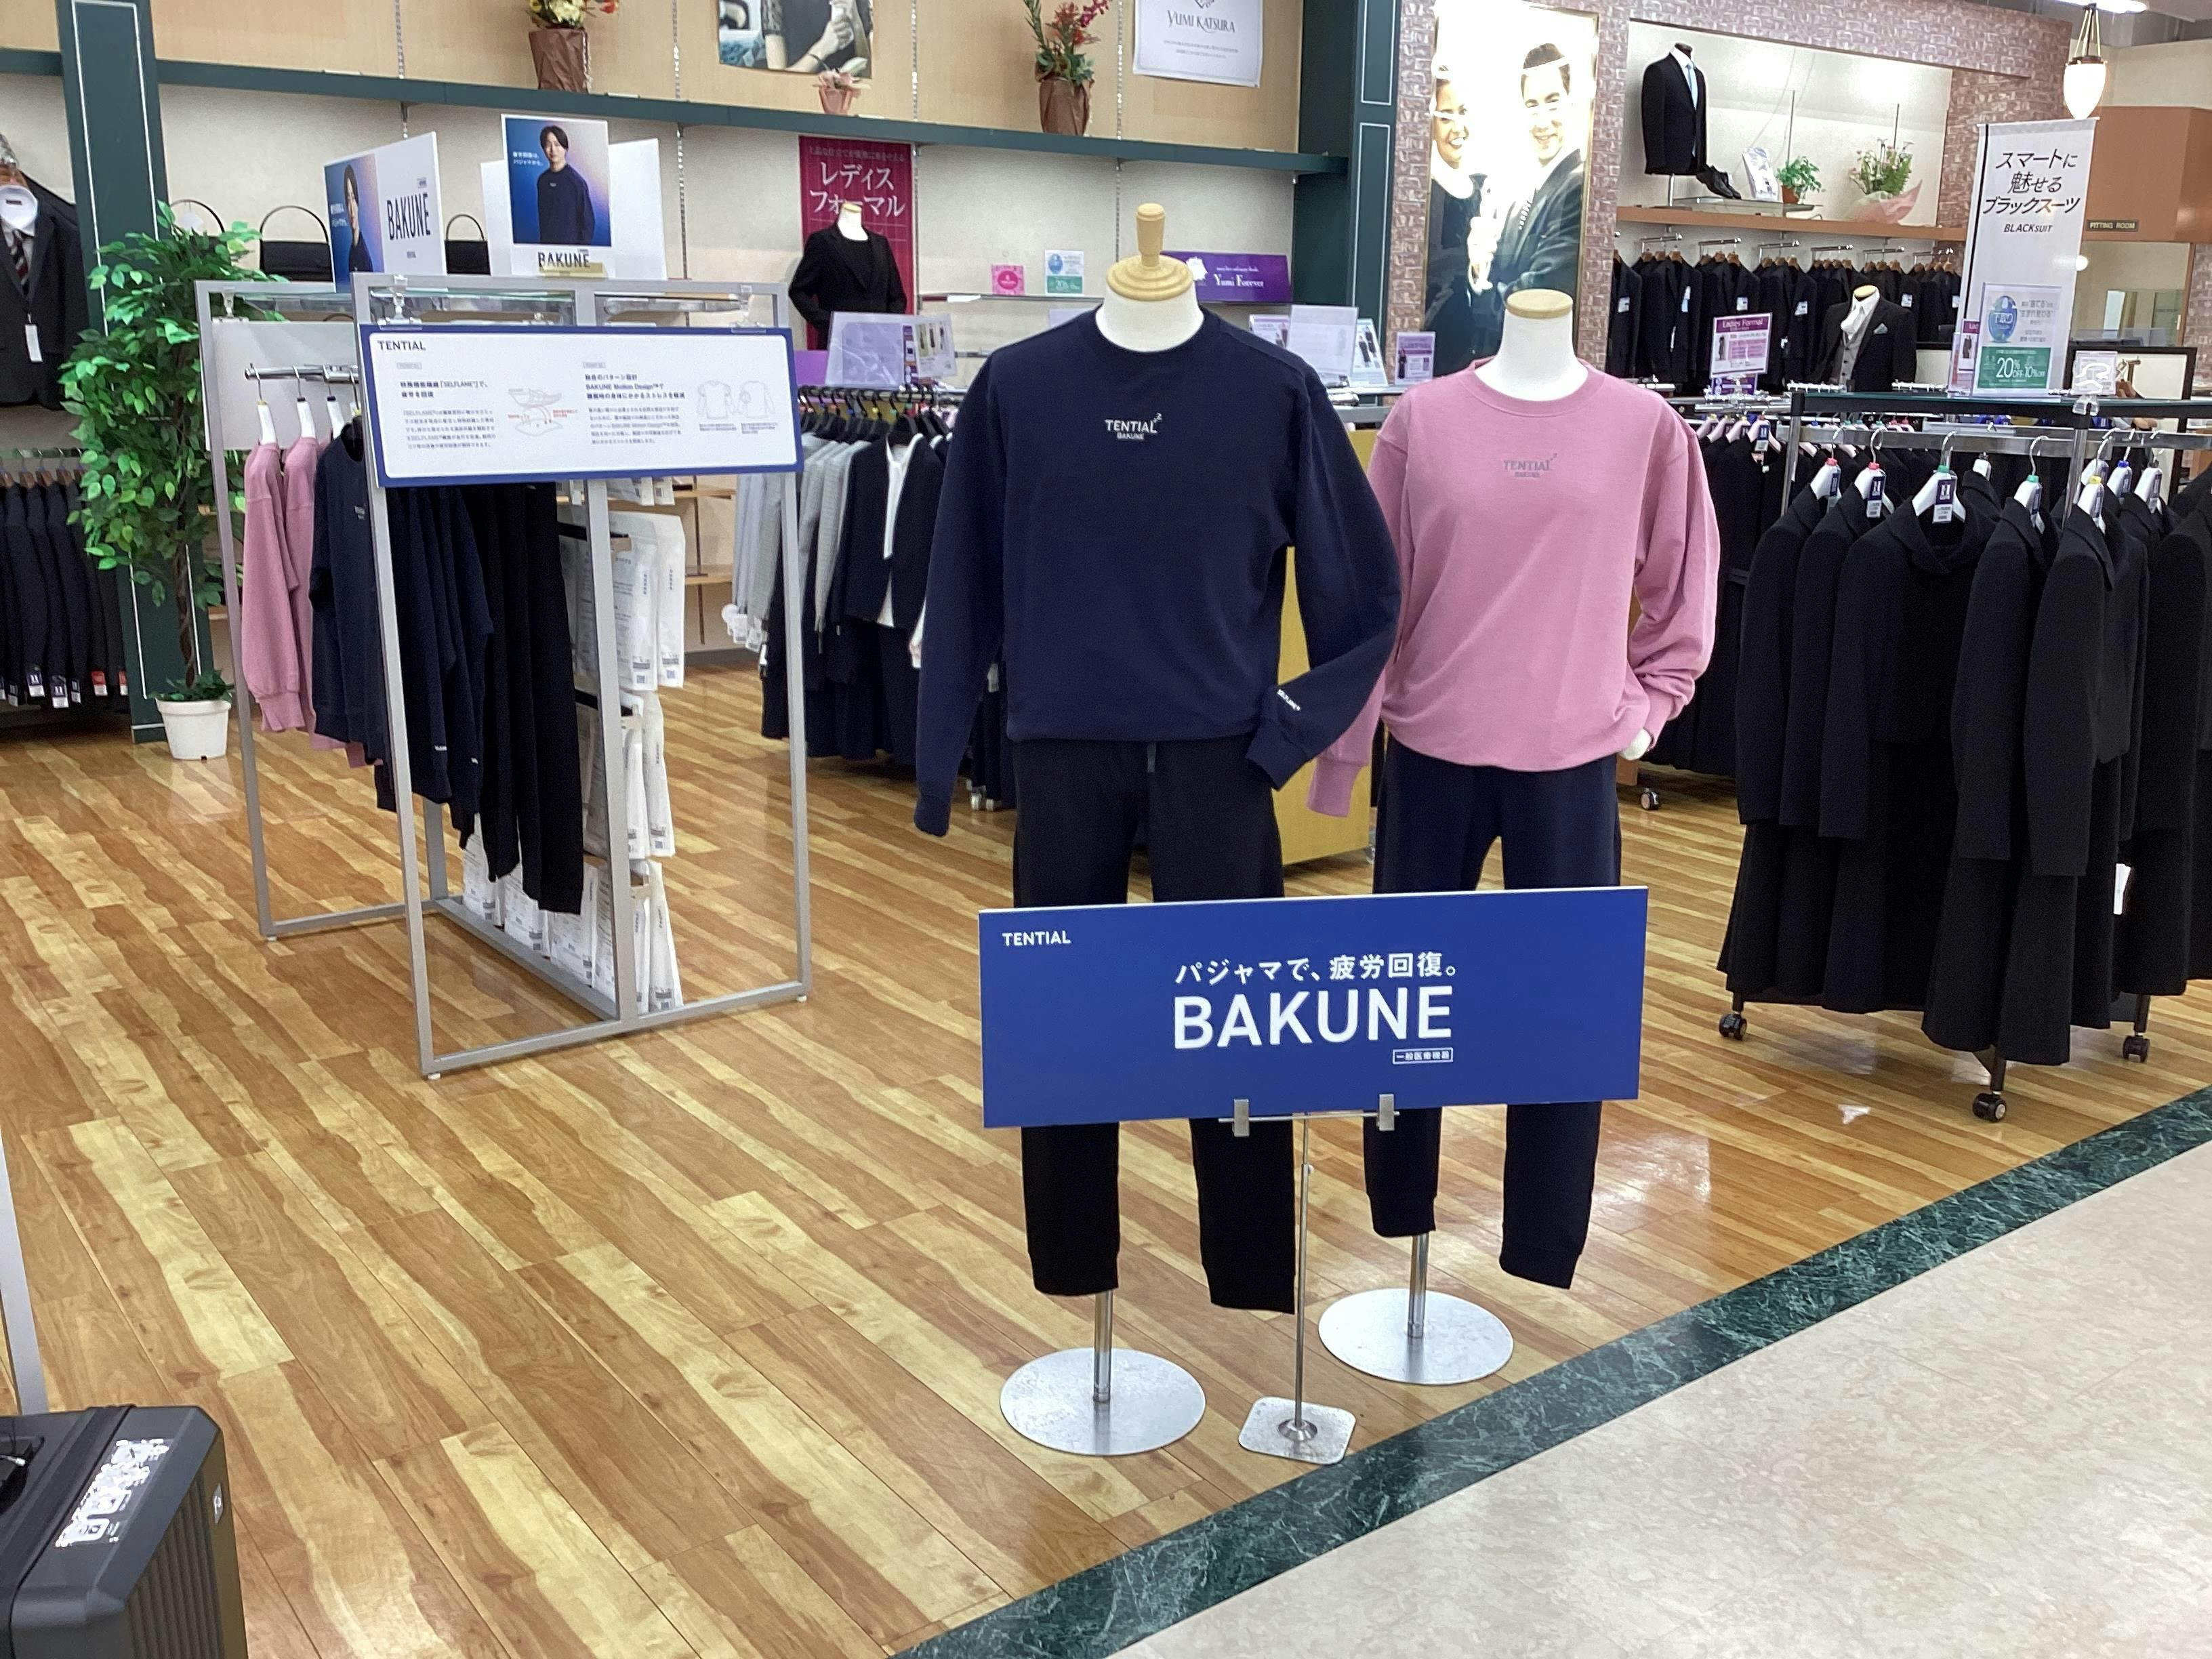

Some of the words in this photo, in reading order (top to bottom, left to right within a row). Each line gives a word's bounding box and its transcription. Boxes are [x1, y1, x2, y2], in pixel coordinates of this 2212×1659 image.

[1167, 9, 1194, 28] YUMI
[1197, 16, 1235, 33] KATSURA
[1995, 148, 2078, 169] スマートに
[820, 161, 895, 190] レディス
[2007, 171, 2062, 194] 魅せる
[809, 189, 906, 218] フォーマル
[1982, 195, 2081, 215] ブラックスーツ
[386, 192, 432, 241] BAKUNE
[537, 251, 591, 269] BAKUNE
[1213, 273, 1235, 286] Yumi
[1235, 274, 1265, 287] Forever
[377, 340, 426, 351] TENTIAL
[1104, 419, 1158, 434] TENTIAL
[1002, 930, 1071, 947] TENTIAL
[1175, 951, 1456, 986] パジャマで、疲労回復。
[1174, 985, 1453, 1049] BAKUNE
